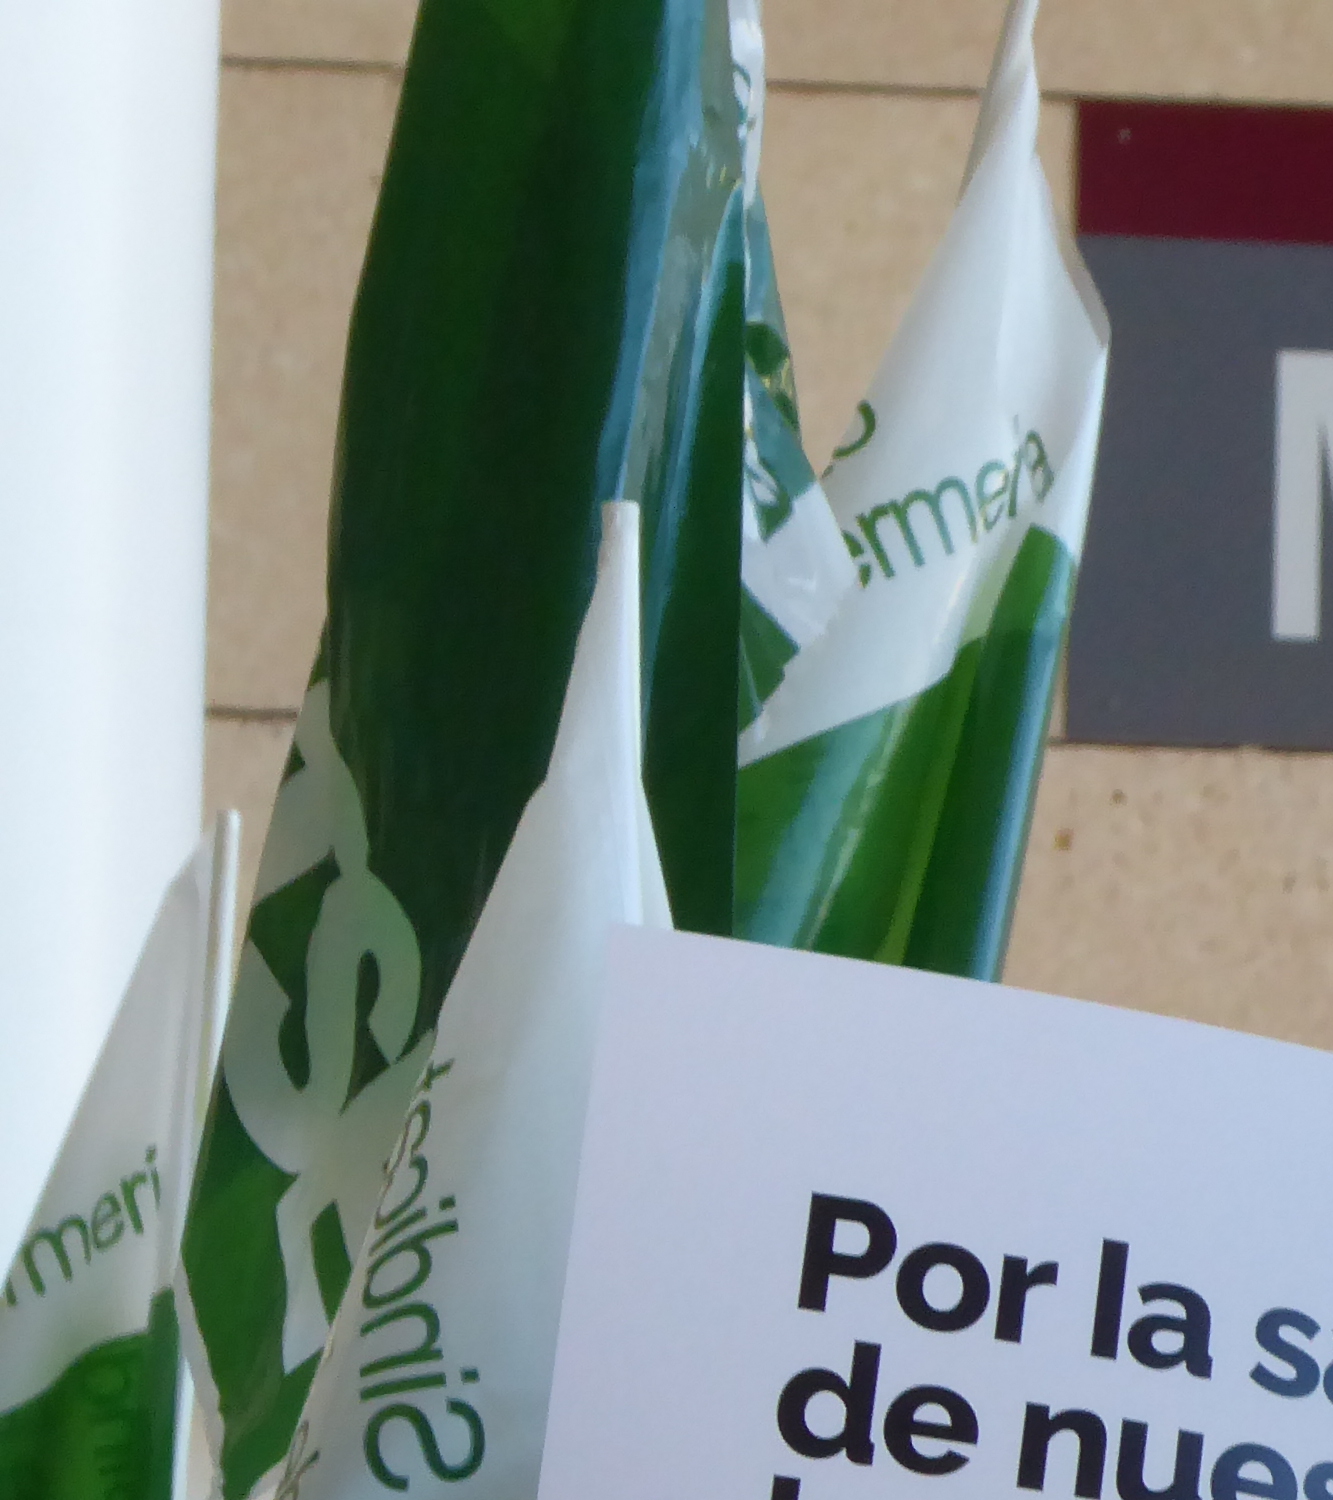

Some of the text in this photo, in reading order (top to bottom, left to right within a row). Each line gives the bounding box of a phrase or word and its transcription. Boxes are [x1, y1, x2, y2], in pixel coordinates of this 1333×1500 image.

[797, 1191, 1058, 1343] Por
[1089, 1238, 1214, 1378] la
[776, 1340, 979, 1476] de
